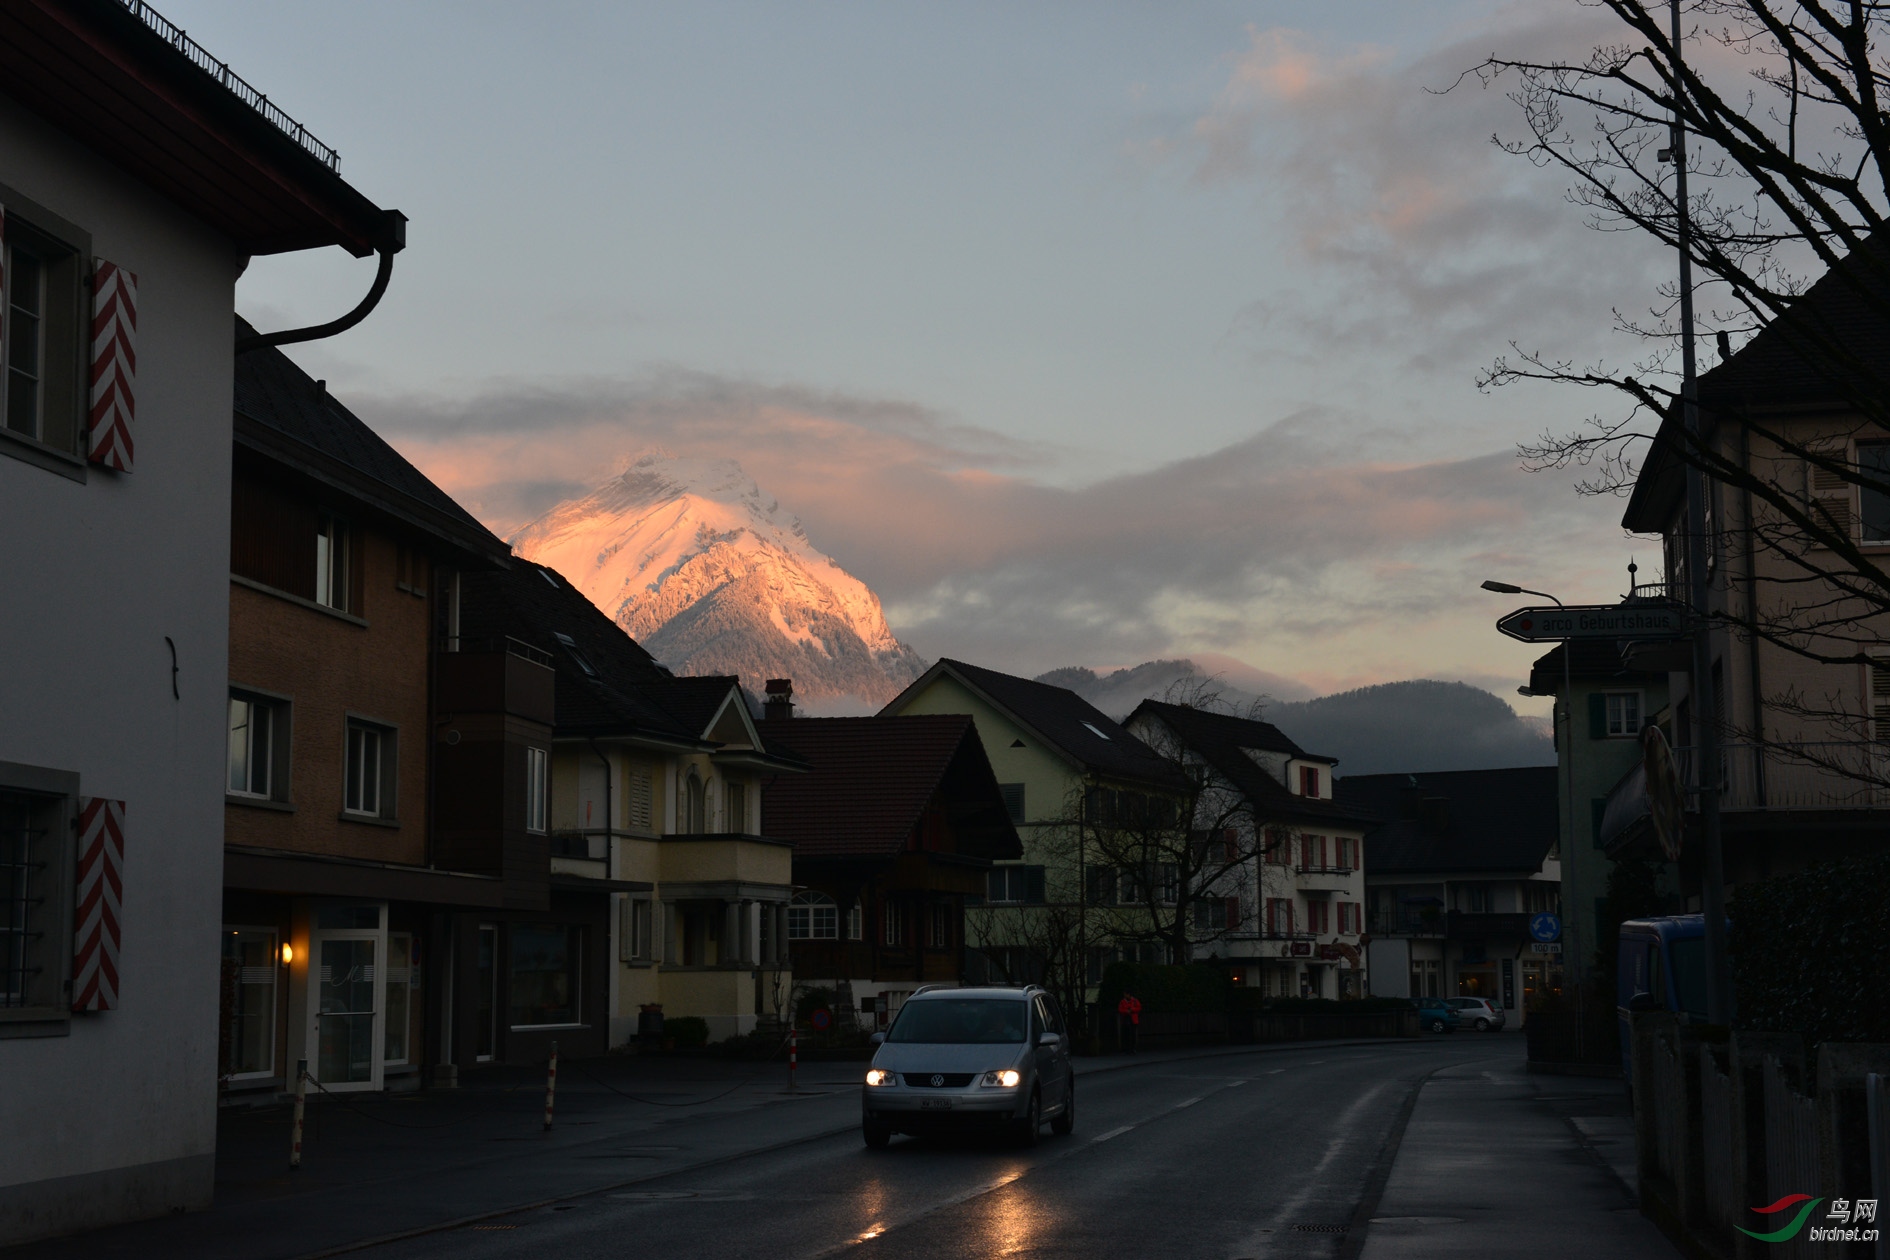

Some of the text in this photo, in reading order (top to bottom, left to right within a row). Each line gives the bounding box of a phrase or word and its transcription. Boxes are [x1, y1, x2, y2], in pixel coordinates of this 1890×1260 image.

[1543, 613, 1670, 631] arco Geburtshaus
[1534, 944, 1549, 952] 100
